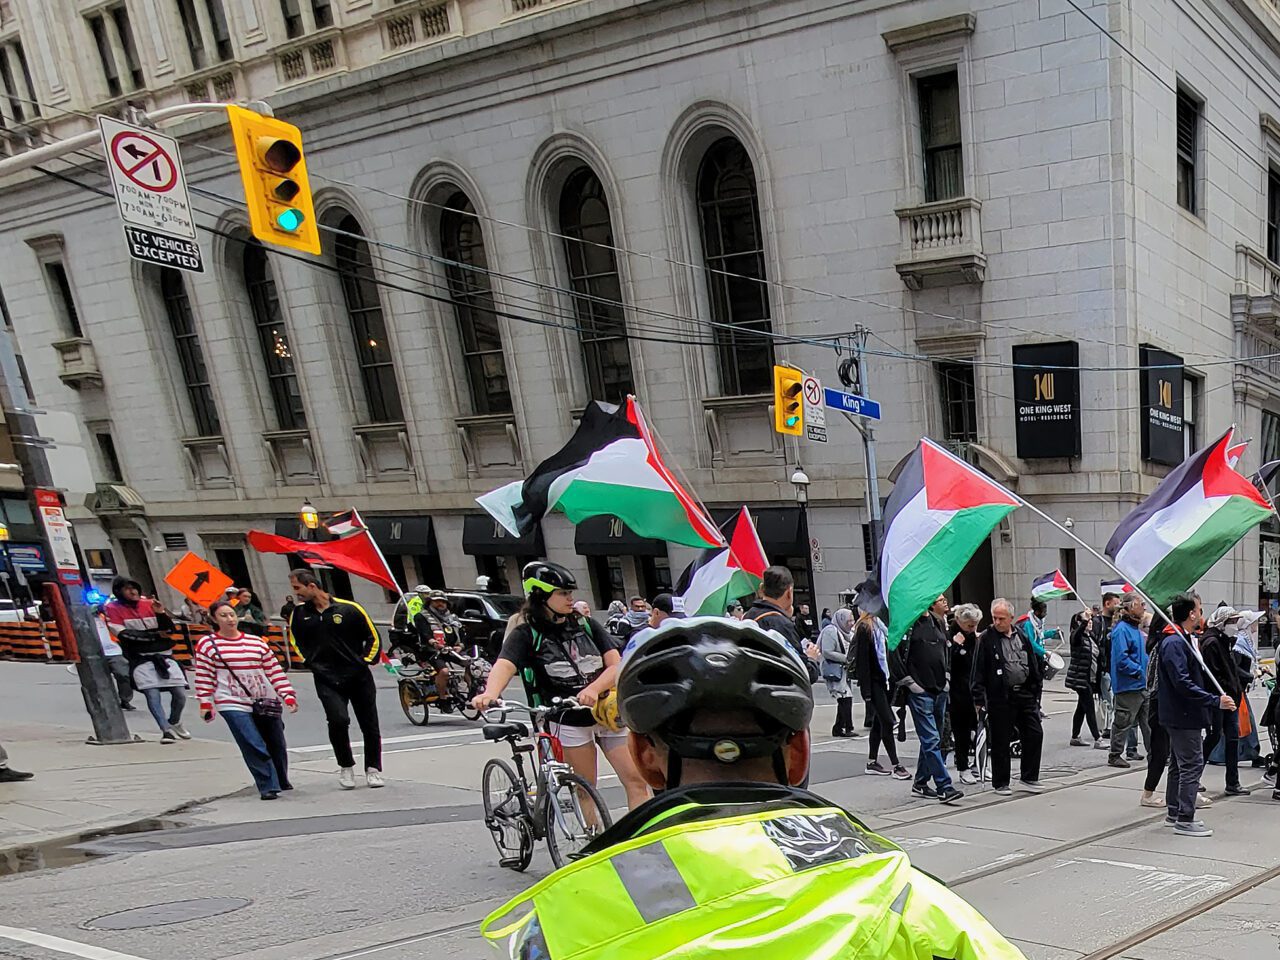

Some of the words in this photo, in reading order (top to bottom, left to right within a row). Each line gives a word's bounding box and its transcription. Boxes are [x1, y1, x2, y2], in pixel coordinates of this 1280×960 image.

[127, 229, 149, 244] TTC
[151, 235, 200, 256] VEHICLES
[133, 244, 199, 268] EXCEPTED
[842, 394, 860, 413] King
[1019, 406, 1034, 415] ONE
[1035, 404, 1053, 414] KING
[1053, 404, 1072, 413] WEST
[1149, 407, 1159, 418] ONE
[1159, 410, 1170, 421] KING
[1169, 413, 1182, 425] WEST
